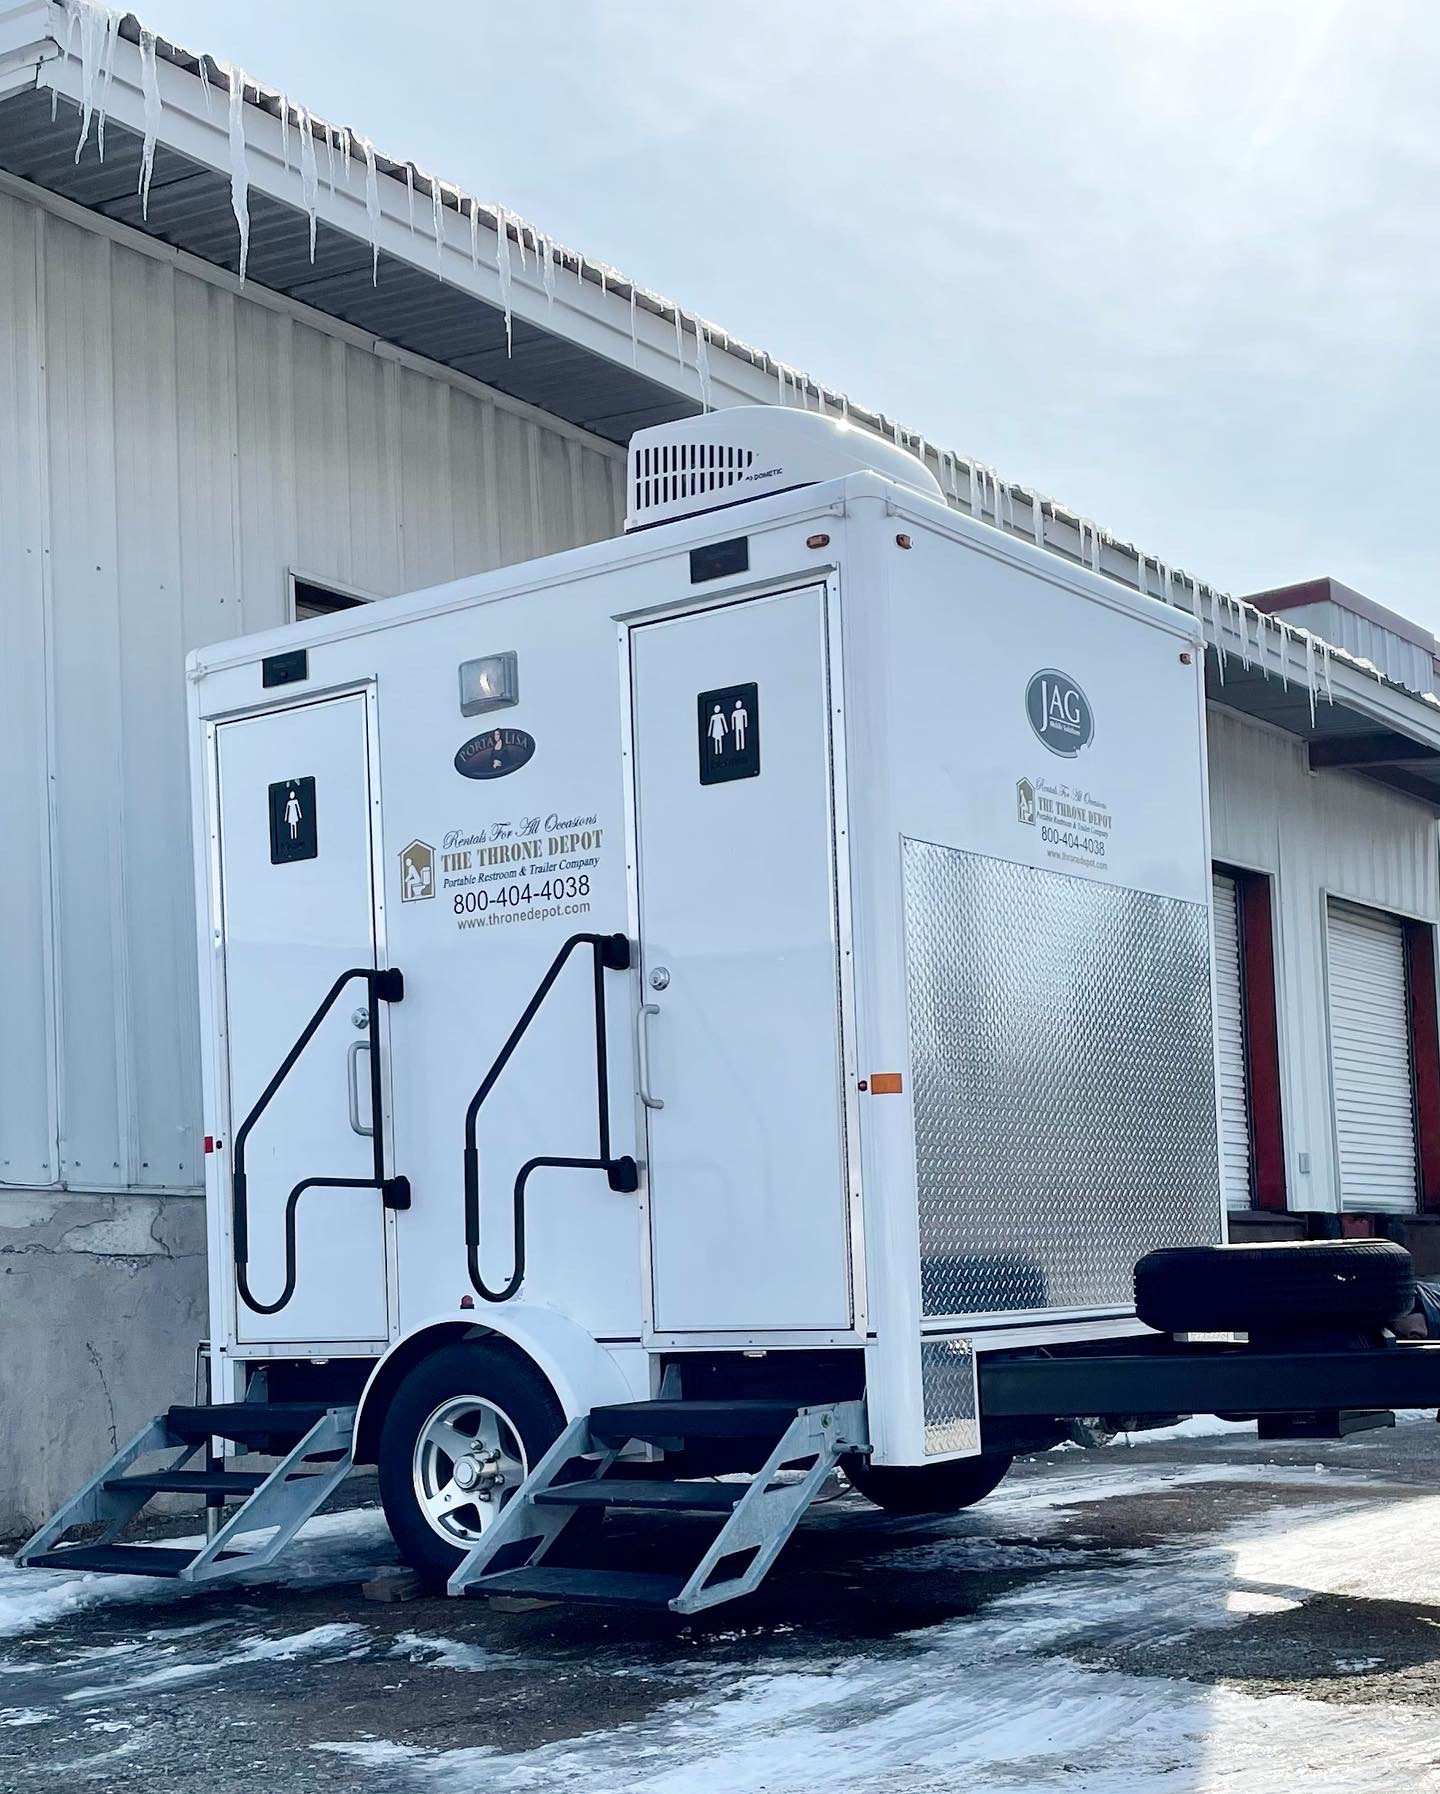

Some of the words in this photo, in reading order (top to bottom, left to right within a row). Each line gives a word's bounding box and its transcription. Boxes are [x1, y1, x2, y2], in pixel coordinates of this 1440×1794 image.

[754, 468, 783, 481] DOMETIC
[1040, 680, 1080, 732] JAG
[460, 737, 494, 762] PORTA
[505, 731, 528, 750] LISA
[1038, 797, 1054, 813] THE
[1056, 802, 1086, 822] THRONE
[1088, 810, 1112, 829] DEPOT
[443, 830, 487, 849] Rentals
[488, 822, 513, 842] For
[515, 817, 540, 836] All
[544, 813, 597, 832] Occasions
[1041, 825, 1105, 856] 800-404-4038
[441, 851, 472, 873] THE
[476, 839, 543, 867] THRONE
[548, 829, 604, 856] DEPOT
[443, 873, 476, 888] Portable
[478, 868, 517, 882] Restroom
[518, 865, 526, 876] &
[529, 861, 557, 875] Trailer
[558, 857, 600, 873] Company
[453, 874, 590, 914] 800-404-4038
[457, 902, 591, 930] www.thronedepot.com
